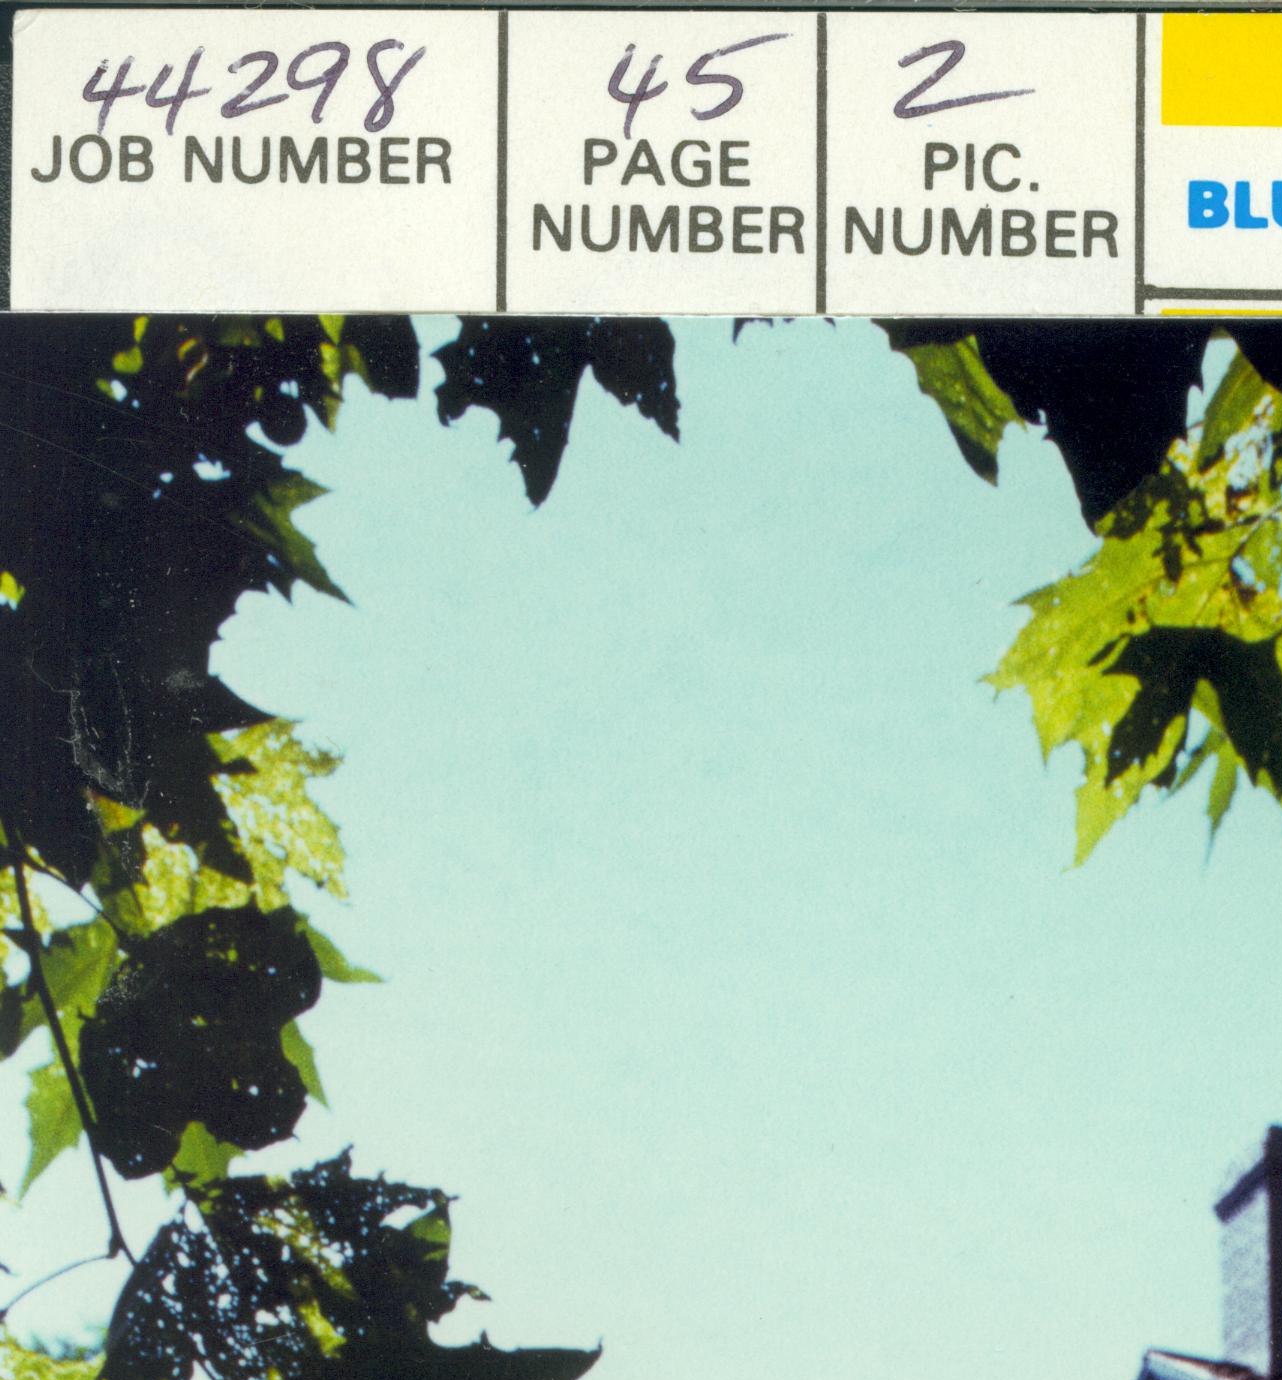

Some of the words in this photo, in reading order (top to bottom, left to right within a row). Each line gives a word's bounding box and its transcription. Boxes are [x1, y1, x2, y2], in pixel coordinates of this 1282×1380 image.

[82, 39, 427, 135] 44298
[608, 32, 794, 139] 45
[893, 40, 1036, 119] 2
[31, 134, 154, 184] JOB
[184, 136, 453, 185] NUMBER
[583, 138, 752, 188] PAGE
[924, 142, 1040, 192] PIC.
[532, 205, 806, 255] NUMBER
[844, 207, 1119, 258] NUMBER
